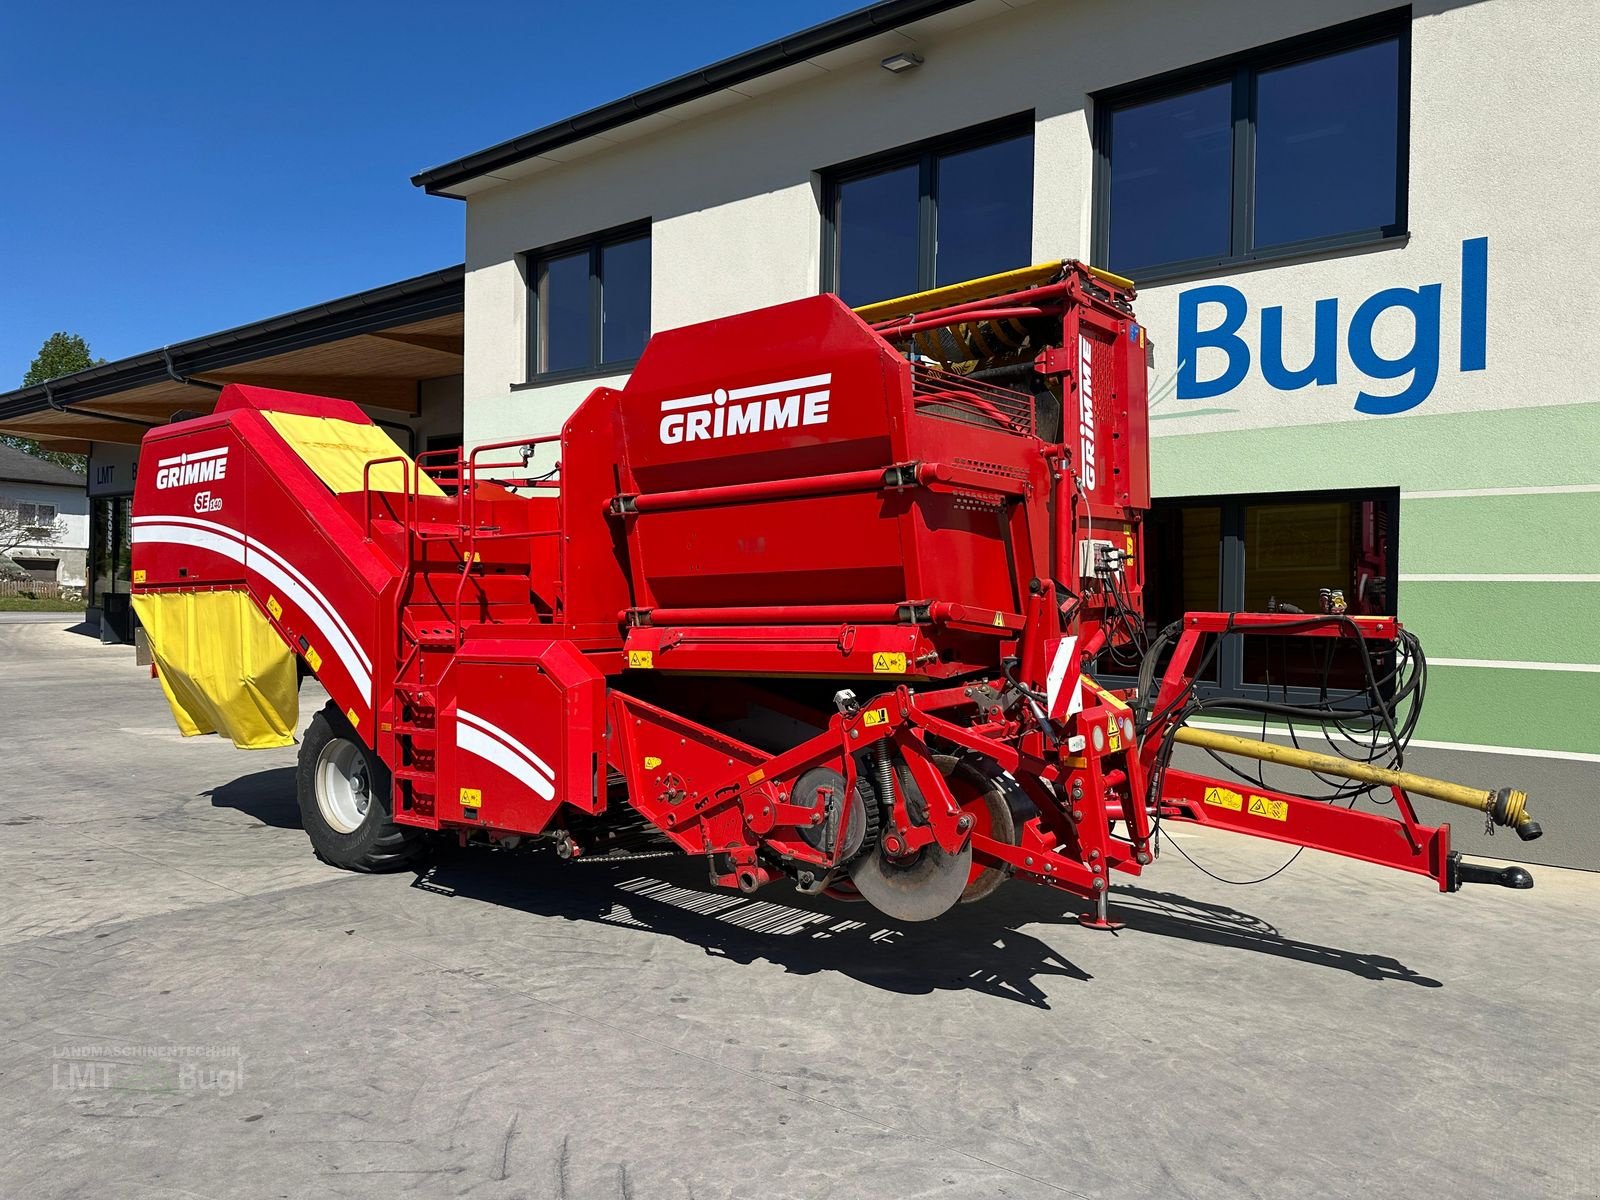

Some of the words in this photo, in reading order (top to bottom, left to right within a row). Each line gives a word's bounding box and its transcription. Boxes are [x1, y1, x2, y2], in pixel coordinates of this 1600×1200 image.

[1176, 236, 1488, 416] Bugl
[659, 387, 831, 445] GRIMME
[1079, 334, 1096, 491] GRIMME
[97, 465, 115, 485] LMT
[156, 452, 228, 490] GRIMME
